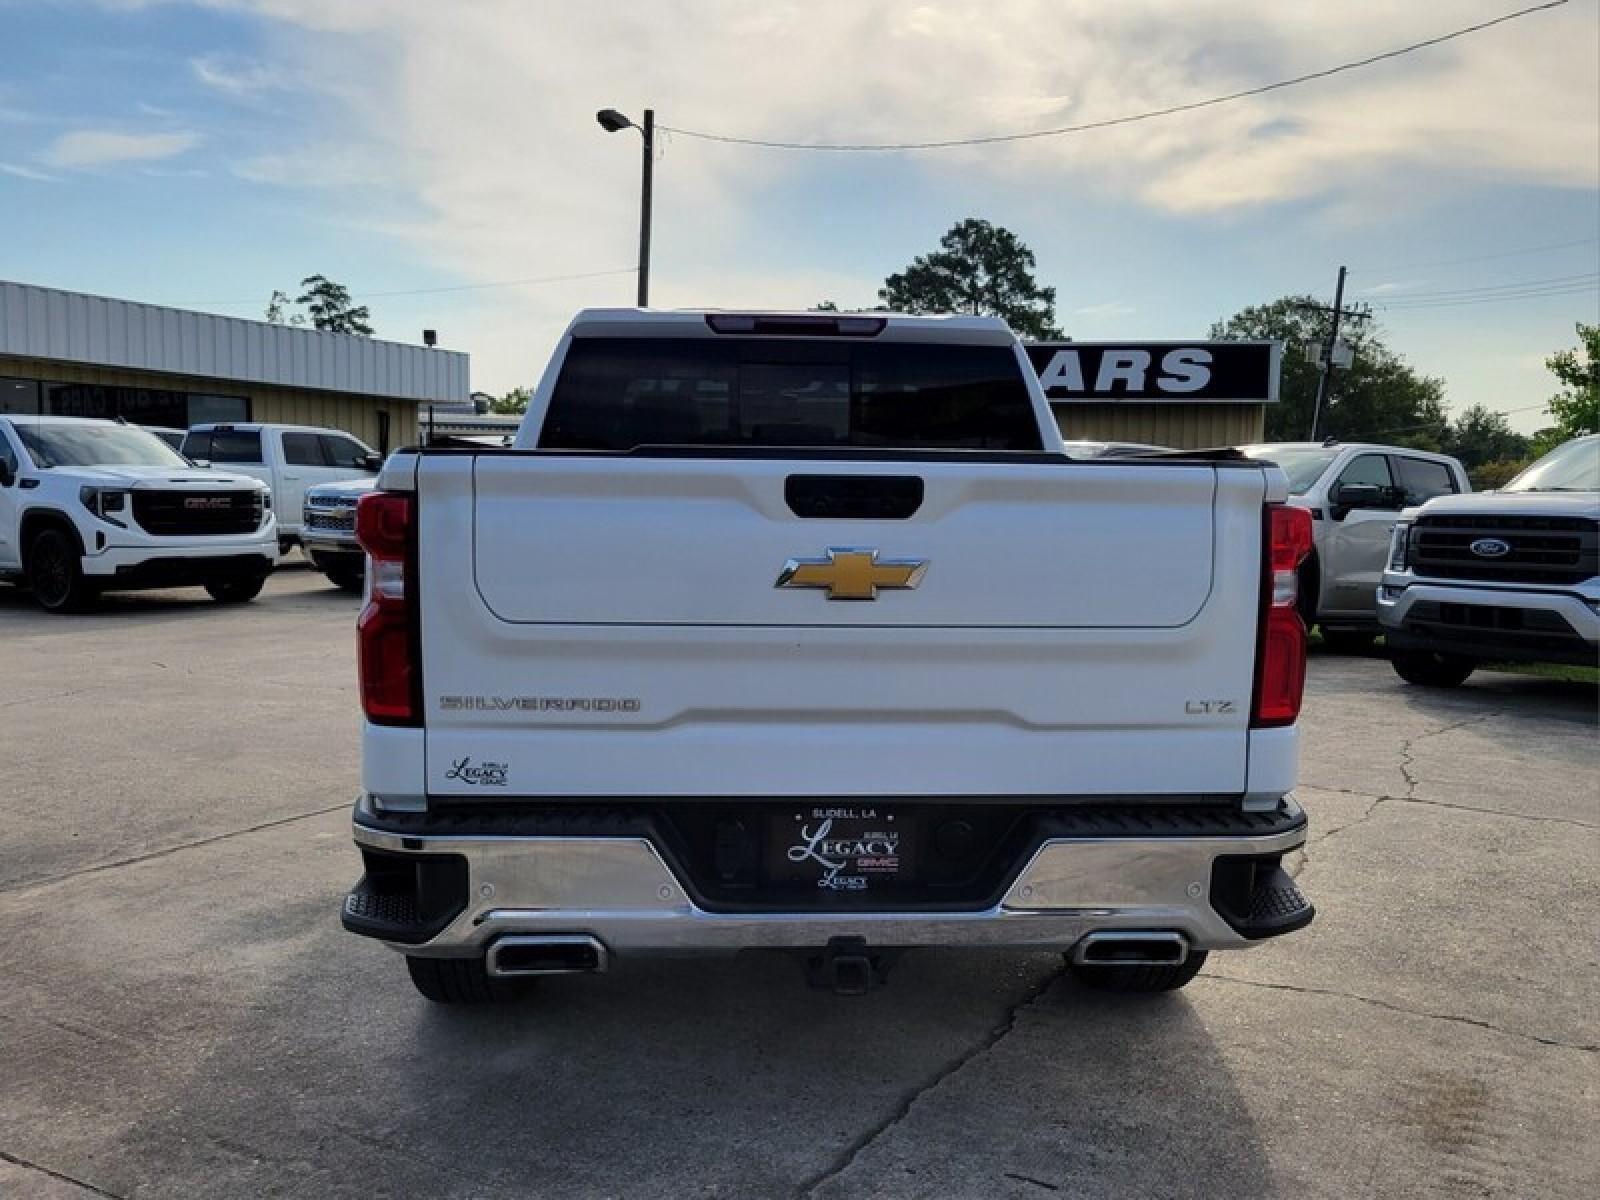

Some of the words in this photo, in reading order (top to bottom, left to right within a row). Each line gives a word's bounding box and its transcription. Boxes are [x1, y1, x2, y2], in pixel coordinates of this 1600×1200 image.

[184, 497, 232, 509] GMC
[440, 696, 641, 712] SILVERADO
[1185, 700, 1236, 714] LTZ
